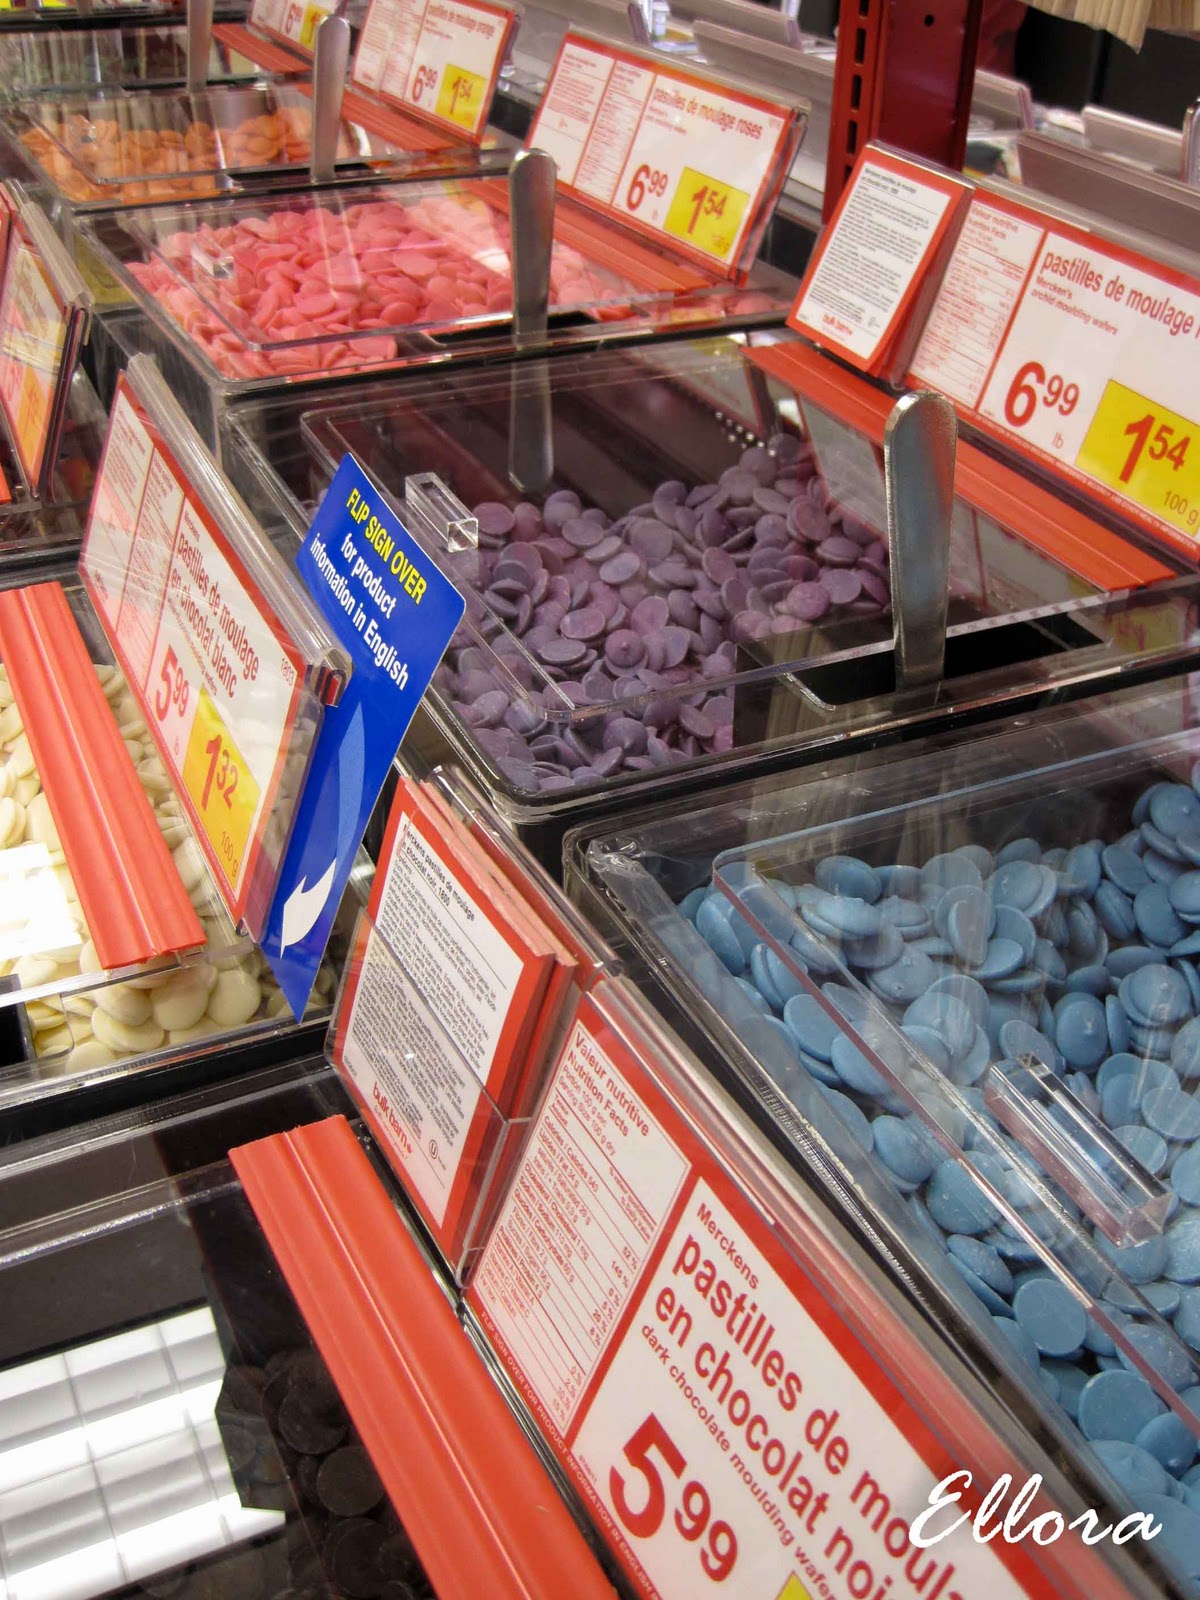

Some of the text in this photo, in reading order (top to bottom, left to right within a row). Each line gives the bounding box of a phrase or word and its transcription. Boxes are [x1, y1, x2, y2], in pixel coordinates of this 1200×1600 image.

[1040, 252, 1194, 336] pastilles de moulage
[346, 487, 427, 605] FLIP SIGN OVER
[1163, 490, 1199, 526] 100 g
[176, 532, 209, 595] pastilles
[208, 582, 220, 616] de
[219, 605, 259, 680] moulage
[310, 533, 409, 690] information in English
[341, 533, 397, 619] for product
[180, 585, 214, 655] chocolat
[211, 637, 237, 698] blanc
[452, 890, 474, 921] moulage
[372, 1081, 390, 1116] bulk
[388, 1109, 408, 1148] barn
[558, 1075, 616, 1156] Serving Size 100 g dry
[562, 1064, 581, 1093] Portion
[582, 1090, 592, 1107] 100
[567, 1050, 628, 1136] Nutrition Facts
[575, 1031, 649, 1136] Valeur nutritive
[544, 1115, 564, 1146] Calories
[566, 1147, 588, 1178] Calories
[588, 1176, 598, 1192] 540
[559, 1156, 568, 1172] Fat
[696, 1202, 760, 1291] Merckens
[480, 1312, 496, 1331] FLIP
[494, 1331, 510, 1359] SIGN
[507, 1356, 525, 1383] OVER
[522, 1381, 539, 1406] FOR
[536, 1405, 569, 1456] PRODUCT
[566, 1456, 612, 1527] INFORMATION
[610, 1527, 622, 1542] IN
[619, 1541, 655, 1593] ENGLISH
[641, 1323, 672, 1366] dark
[669, 1364, 730, 1453] chocolate
[730, 1454, 796, 1548] moulding
[654, 1285, 897, 1600] en chocolat noi
[672, 1233, 966, 1600] pastilles de moul
